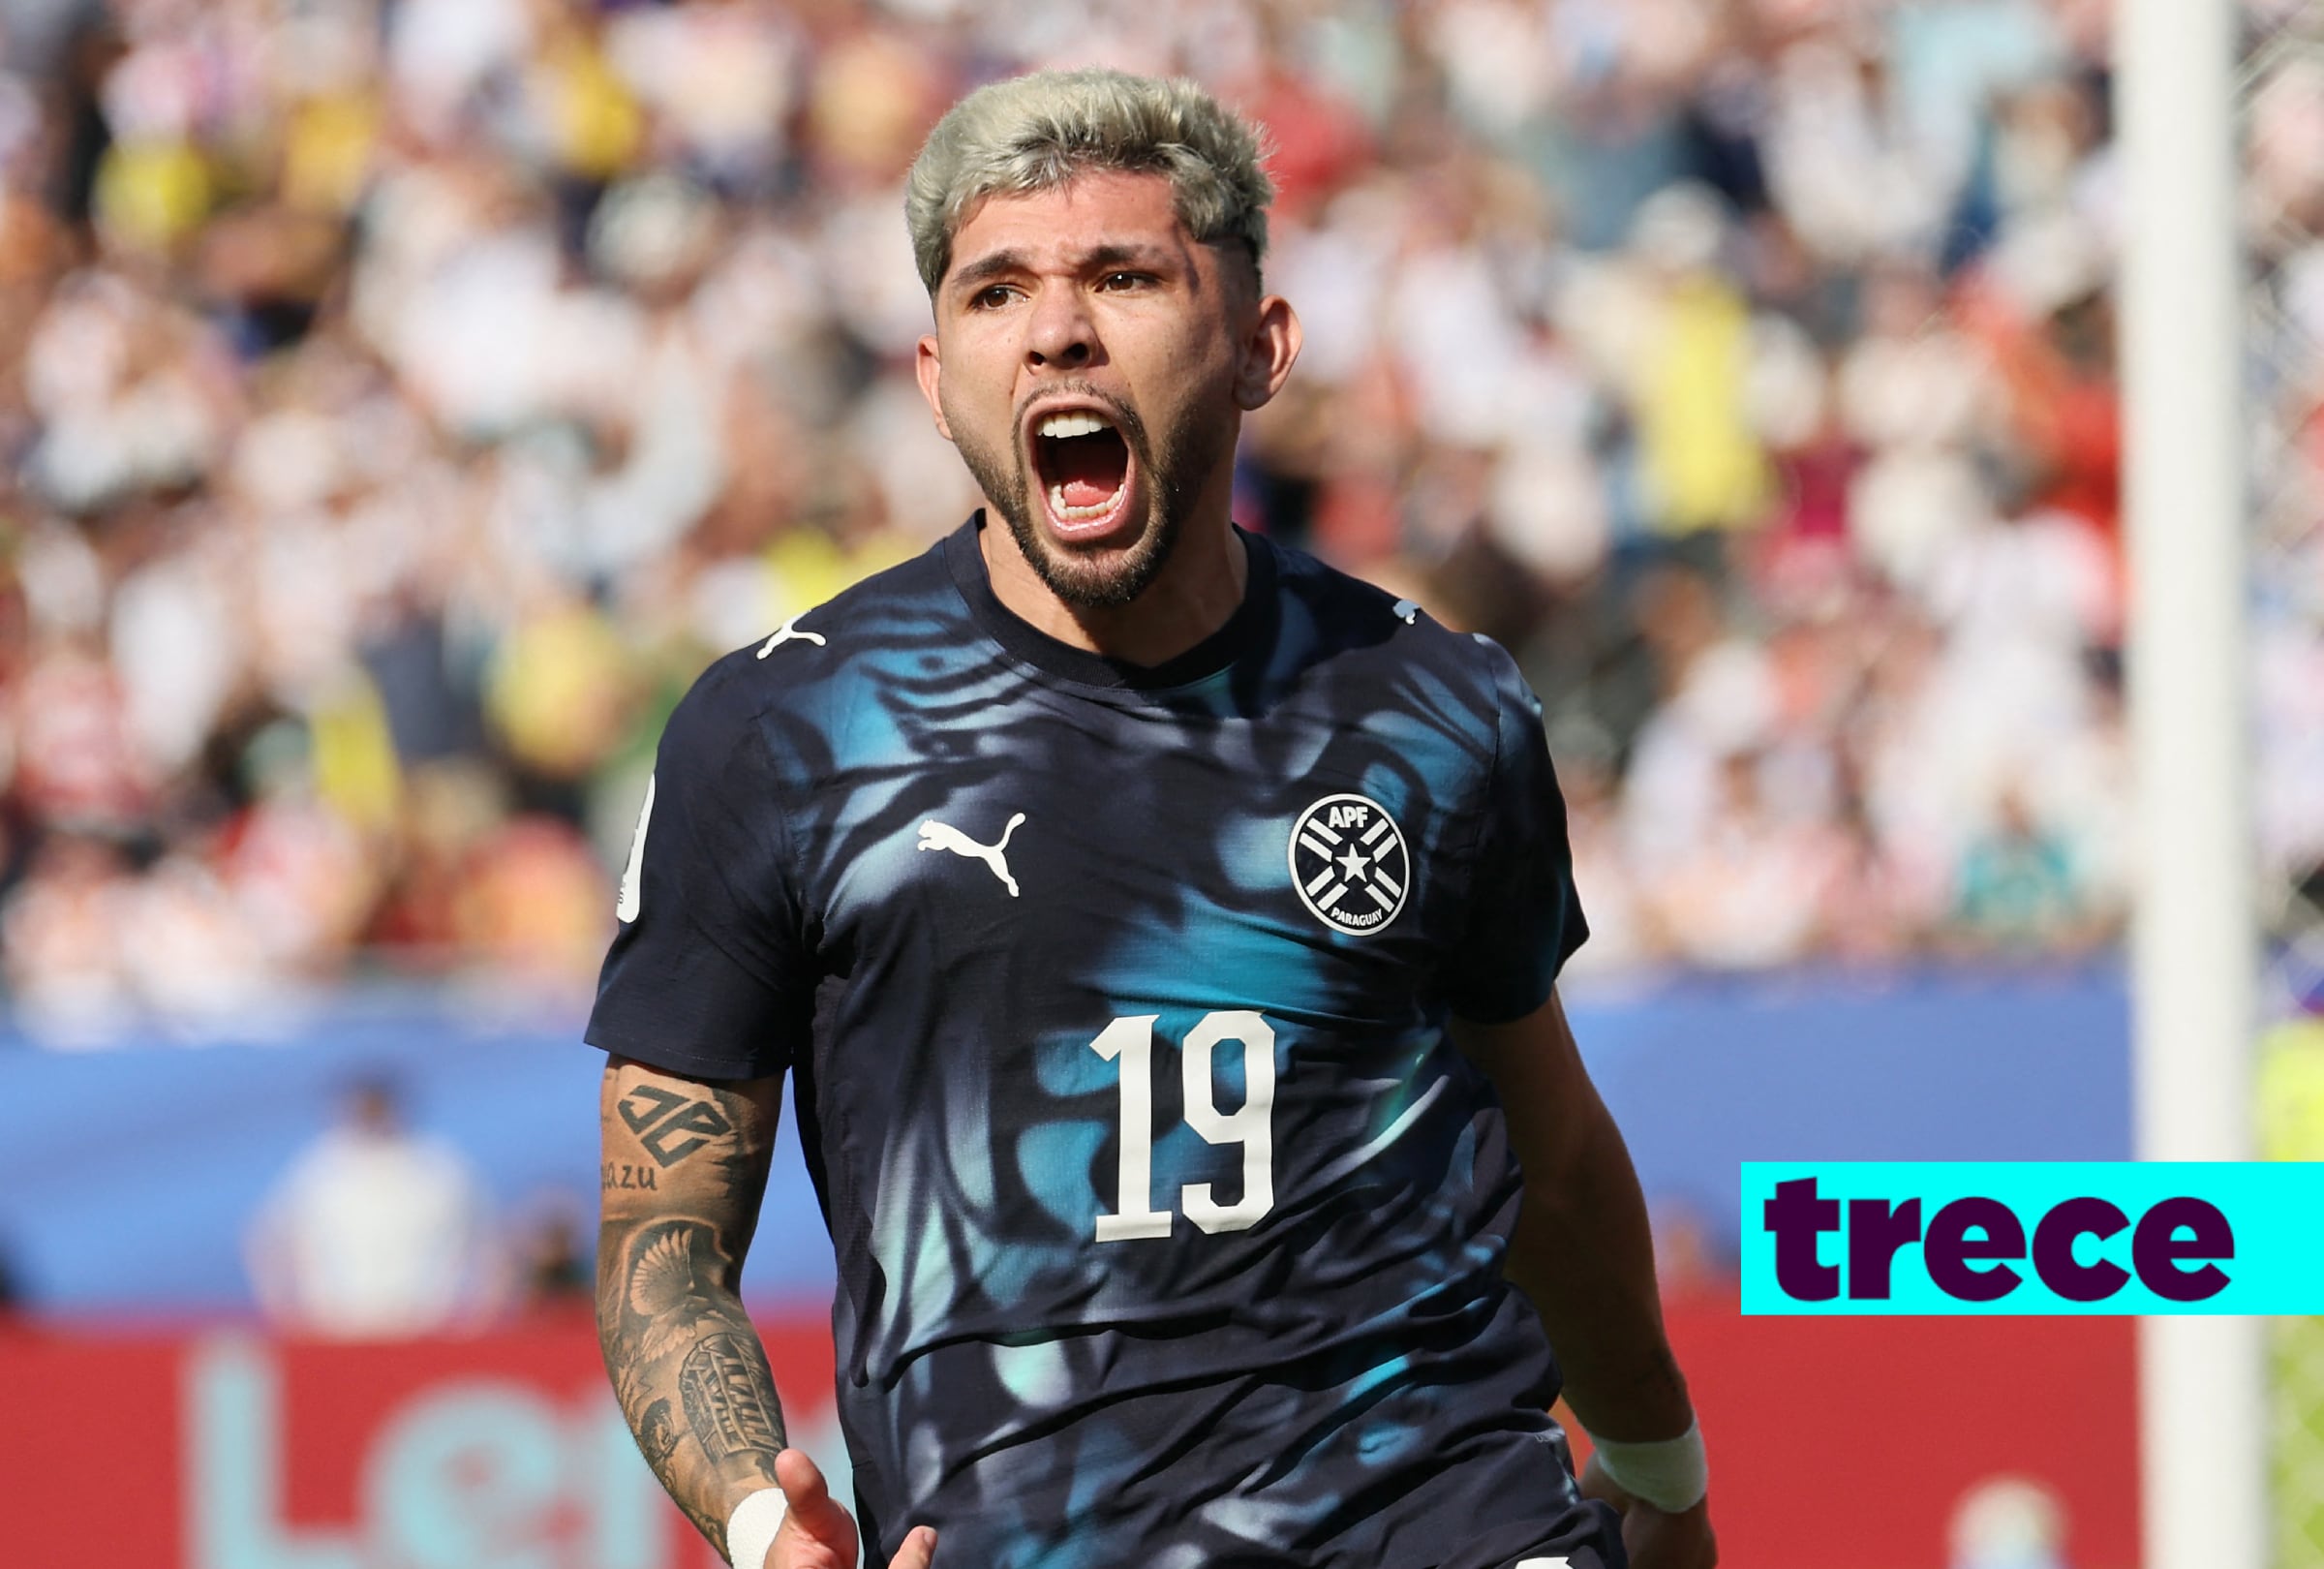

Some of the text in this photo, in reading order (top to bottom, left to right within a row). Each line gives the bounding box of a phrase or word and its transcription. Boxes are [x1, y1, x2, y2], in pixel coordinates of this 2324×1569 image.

[1329, 806, 1368, 828] APF
[1330, 907, 1384, 927] PARAGUAY
[1088, 1009, 1276, 1243] 19
